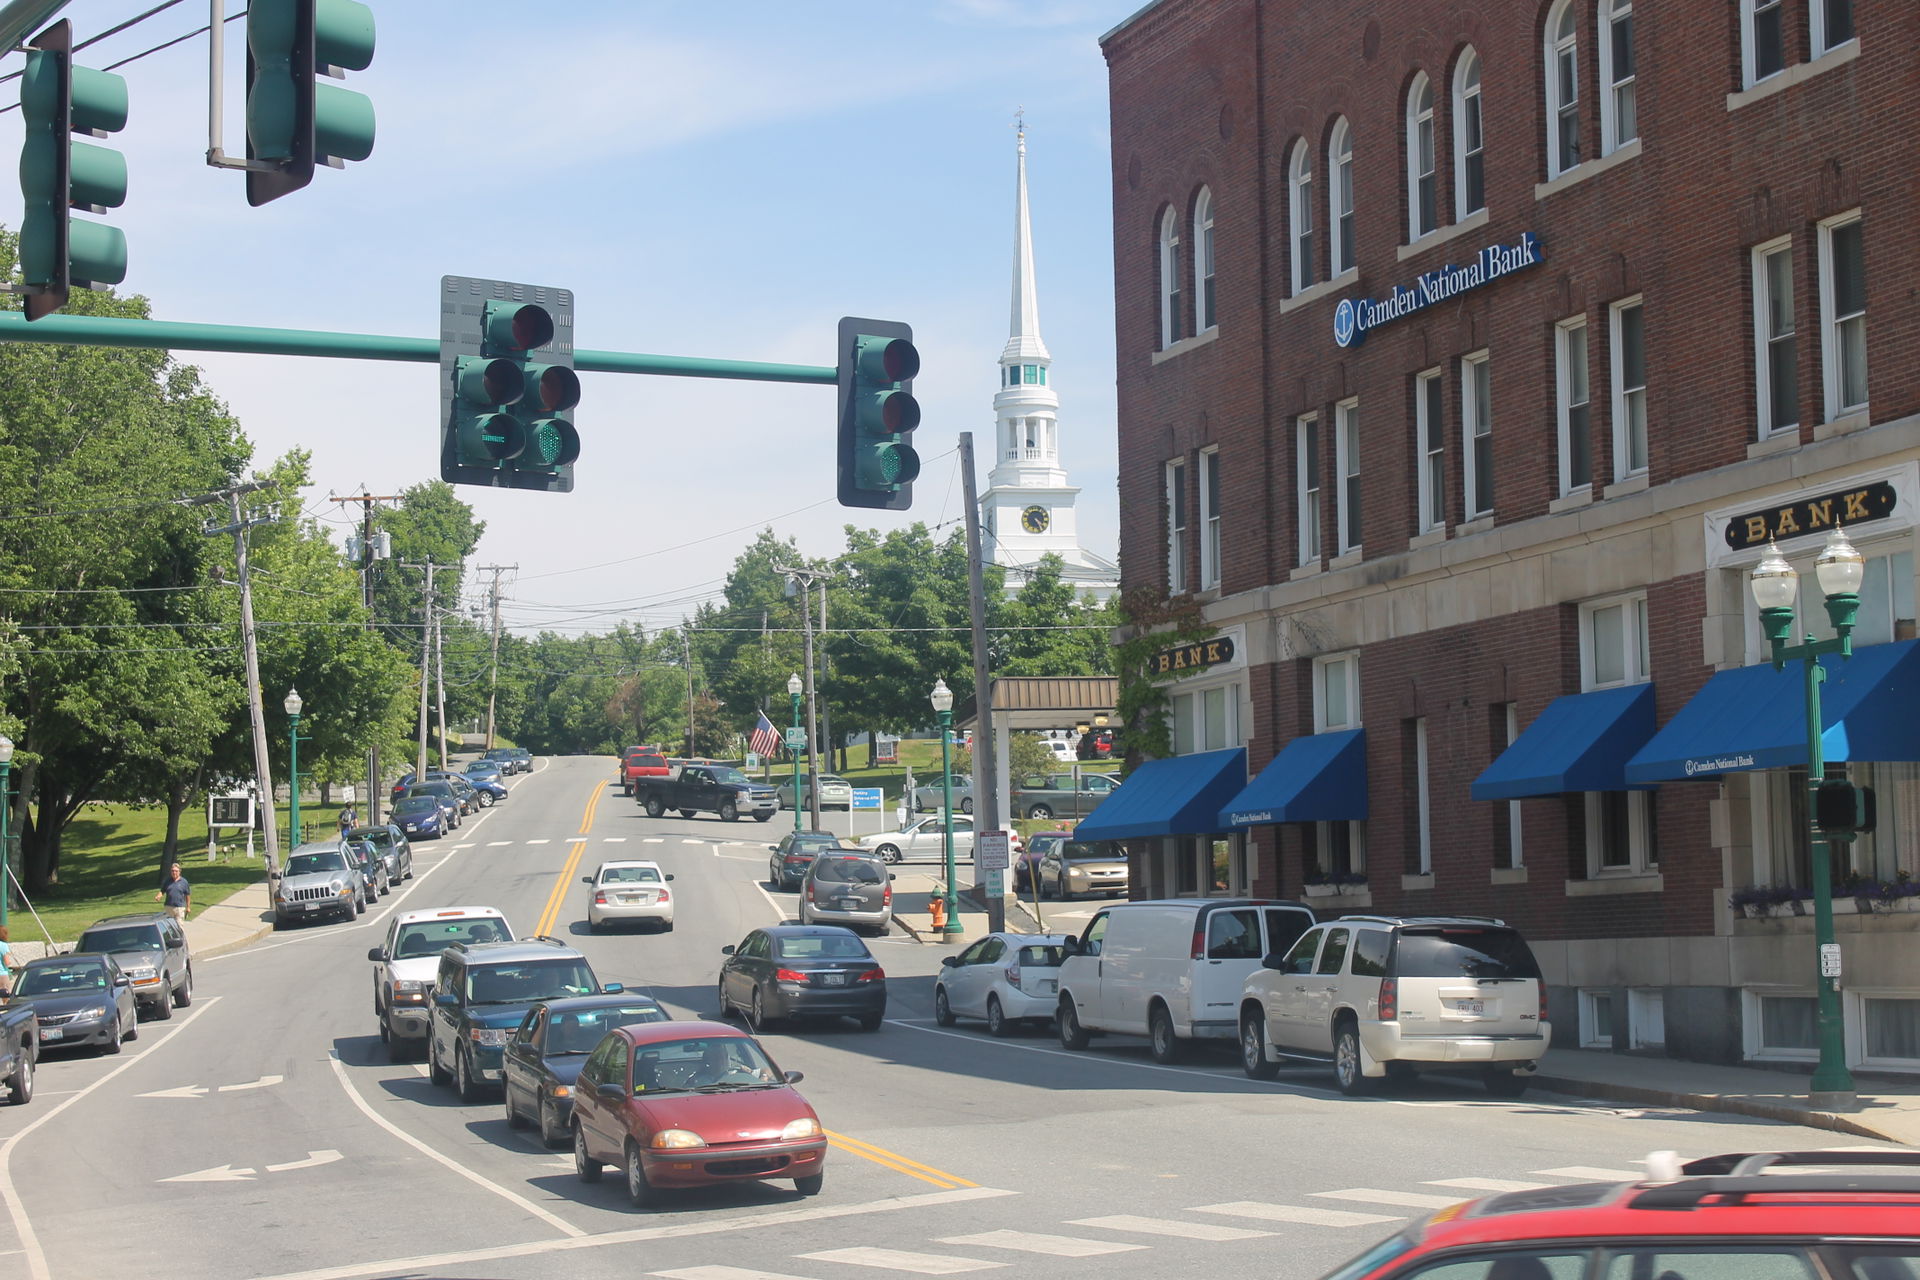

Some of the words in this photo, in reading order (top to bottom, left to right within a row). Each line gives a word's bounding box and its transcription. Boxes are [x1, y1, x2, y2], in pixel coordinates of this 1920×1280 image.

[1357, 286, 1417, 331] Camden
[1417, 251, 1485, 308] National
[1488, 232, 1535, 279] Bank
[1745, 490, 1869, 543] BANK
[1158, 642, 1220, 673] BANK
[1693, 760, 1715, 772] Camden
[1715, 757, 1738, 769] National
[1738, 754, 1754, 767] Bank
